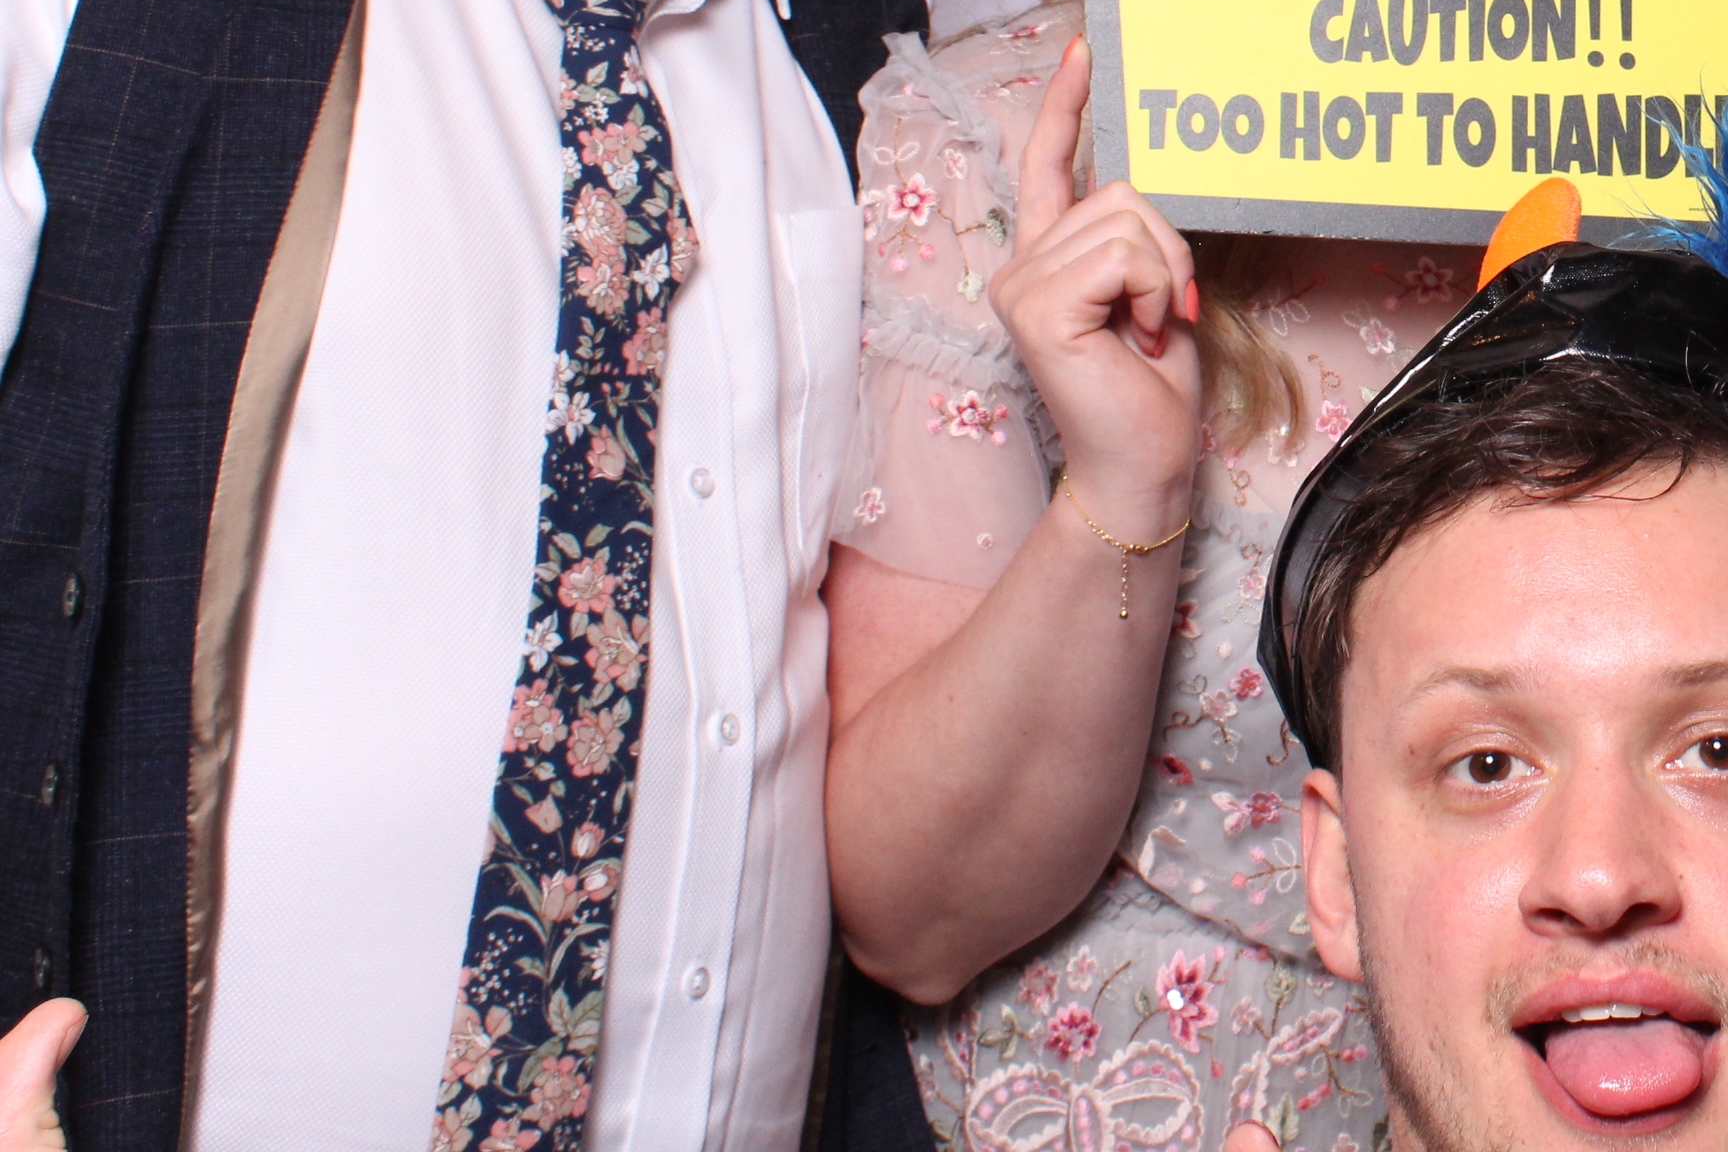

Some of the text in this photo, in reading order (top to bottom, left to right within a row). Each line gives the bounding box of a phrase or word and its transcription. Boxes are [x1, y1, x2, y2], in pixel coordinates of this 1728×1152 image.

[1139, 89, 1265, 153] TOO
[1279, 90, 1403, 163] HOT
[1416, 92, 1497, 168] TO
